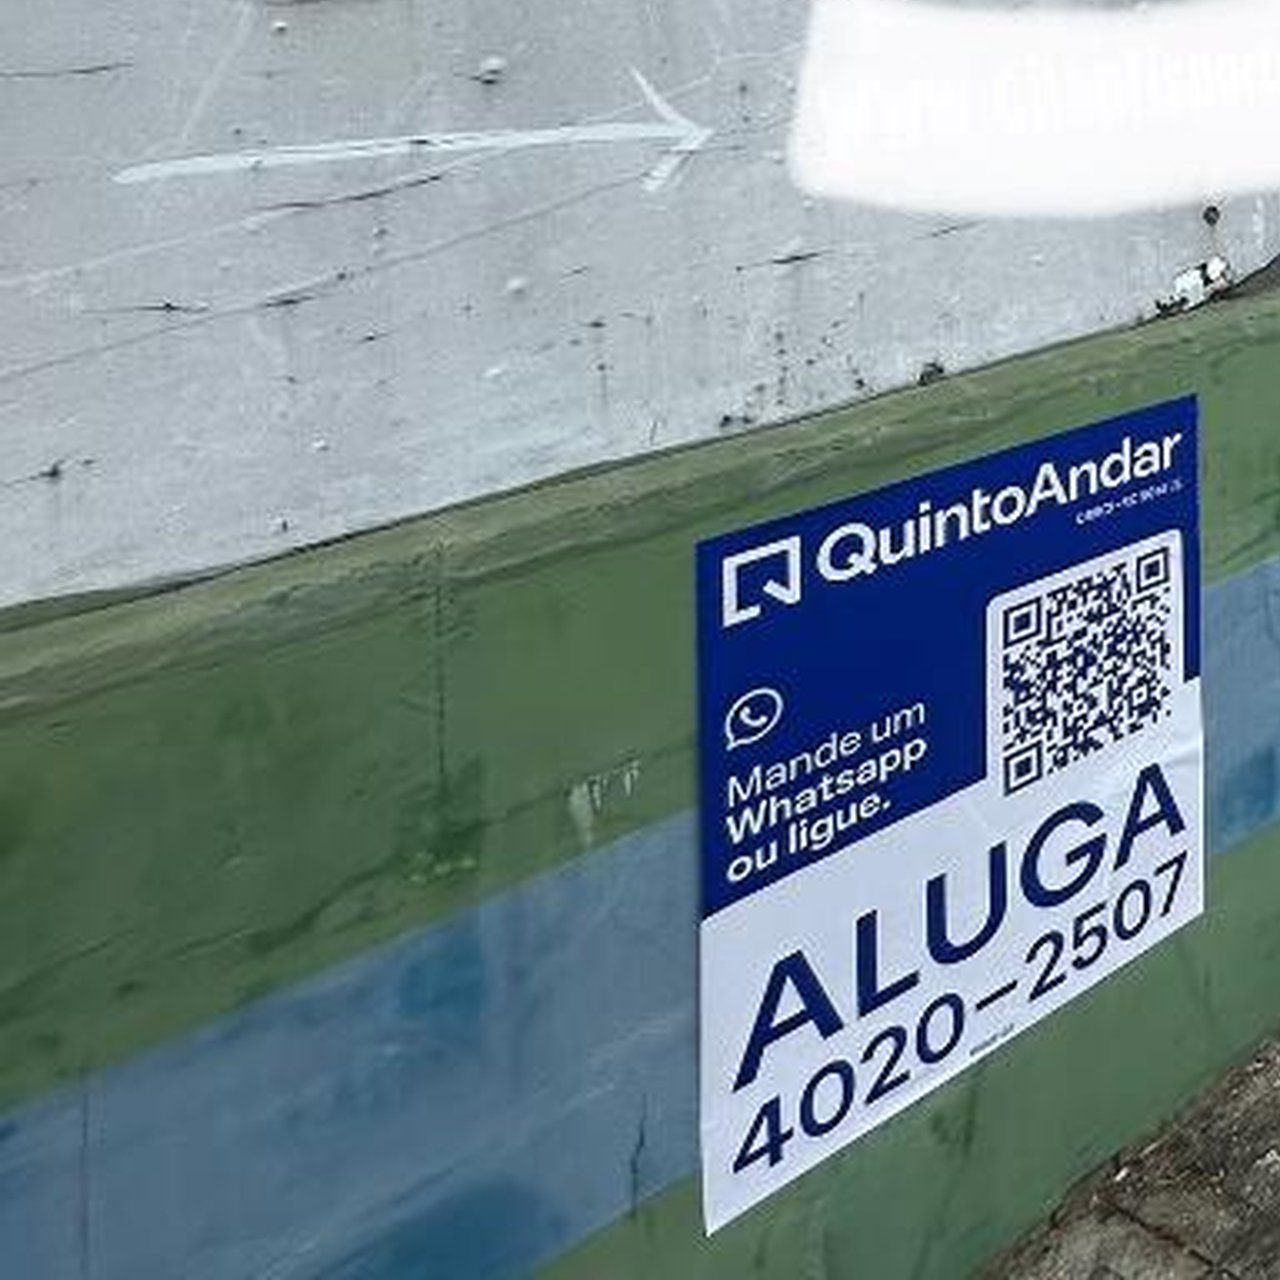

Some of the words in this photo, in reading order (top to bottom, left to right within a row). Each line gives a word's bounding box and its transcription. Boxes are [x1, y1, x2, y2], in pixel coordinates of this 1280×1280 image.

[816, 432, 1183, 583] QuintoAndar
[725, 738, 928, 845] Whatsapp
[728, 732, 861, 808] Mande
[871, 702, 925, 743] um
[726, 840, 778, 883] ou
[788, 793, 891, 855] ligue.
[732, 762, 1187, 1093] ALUGA
[732, 851, 1188, 1175] 4020-2507
